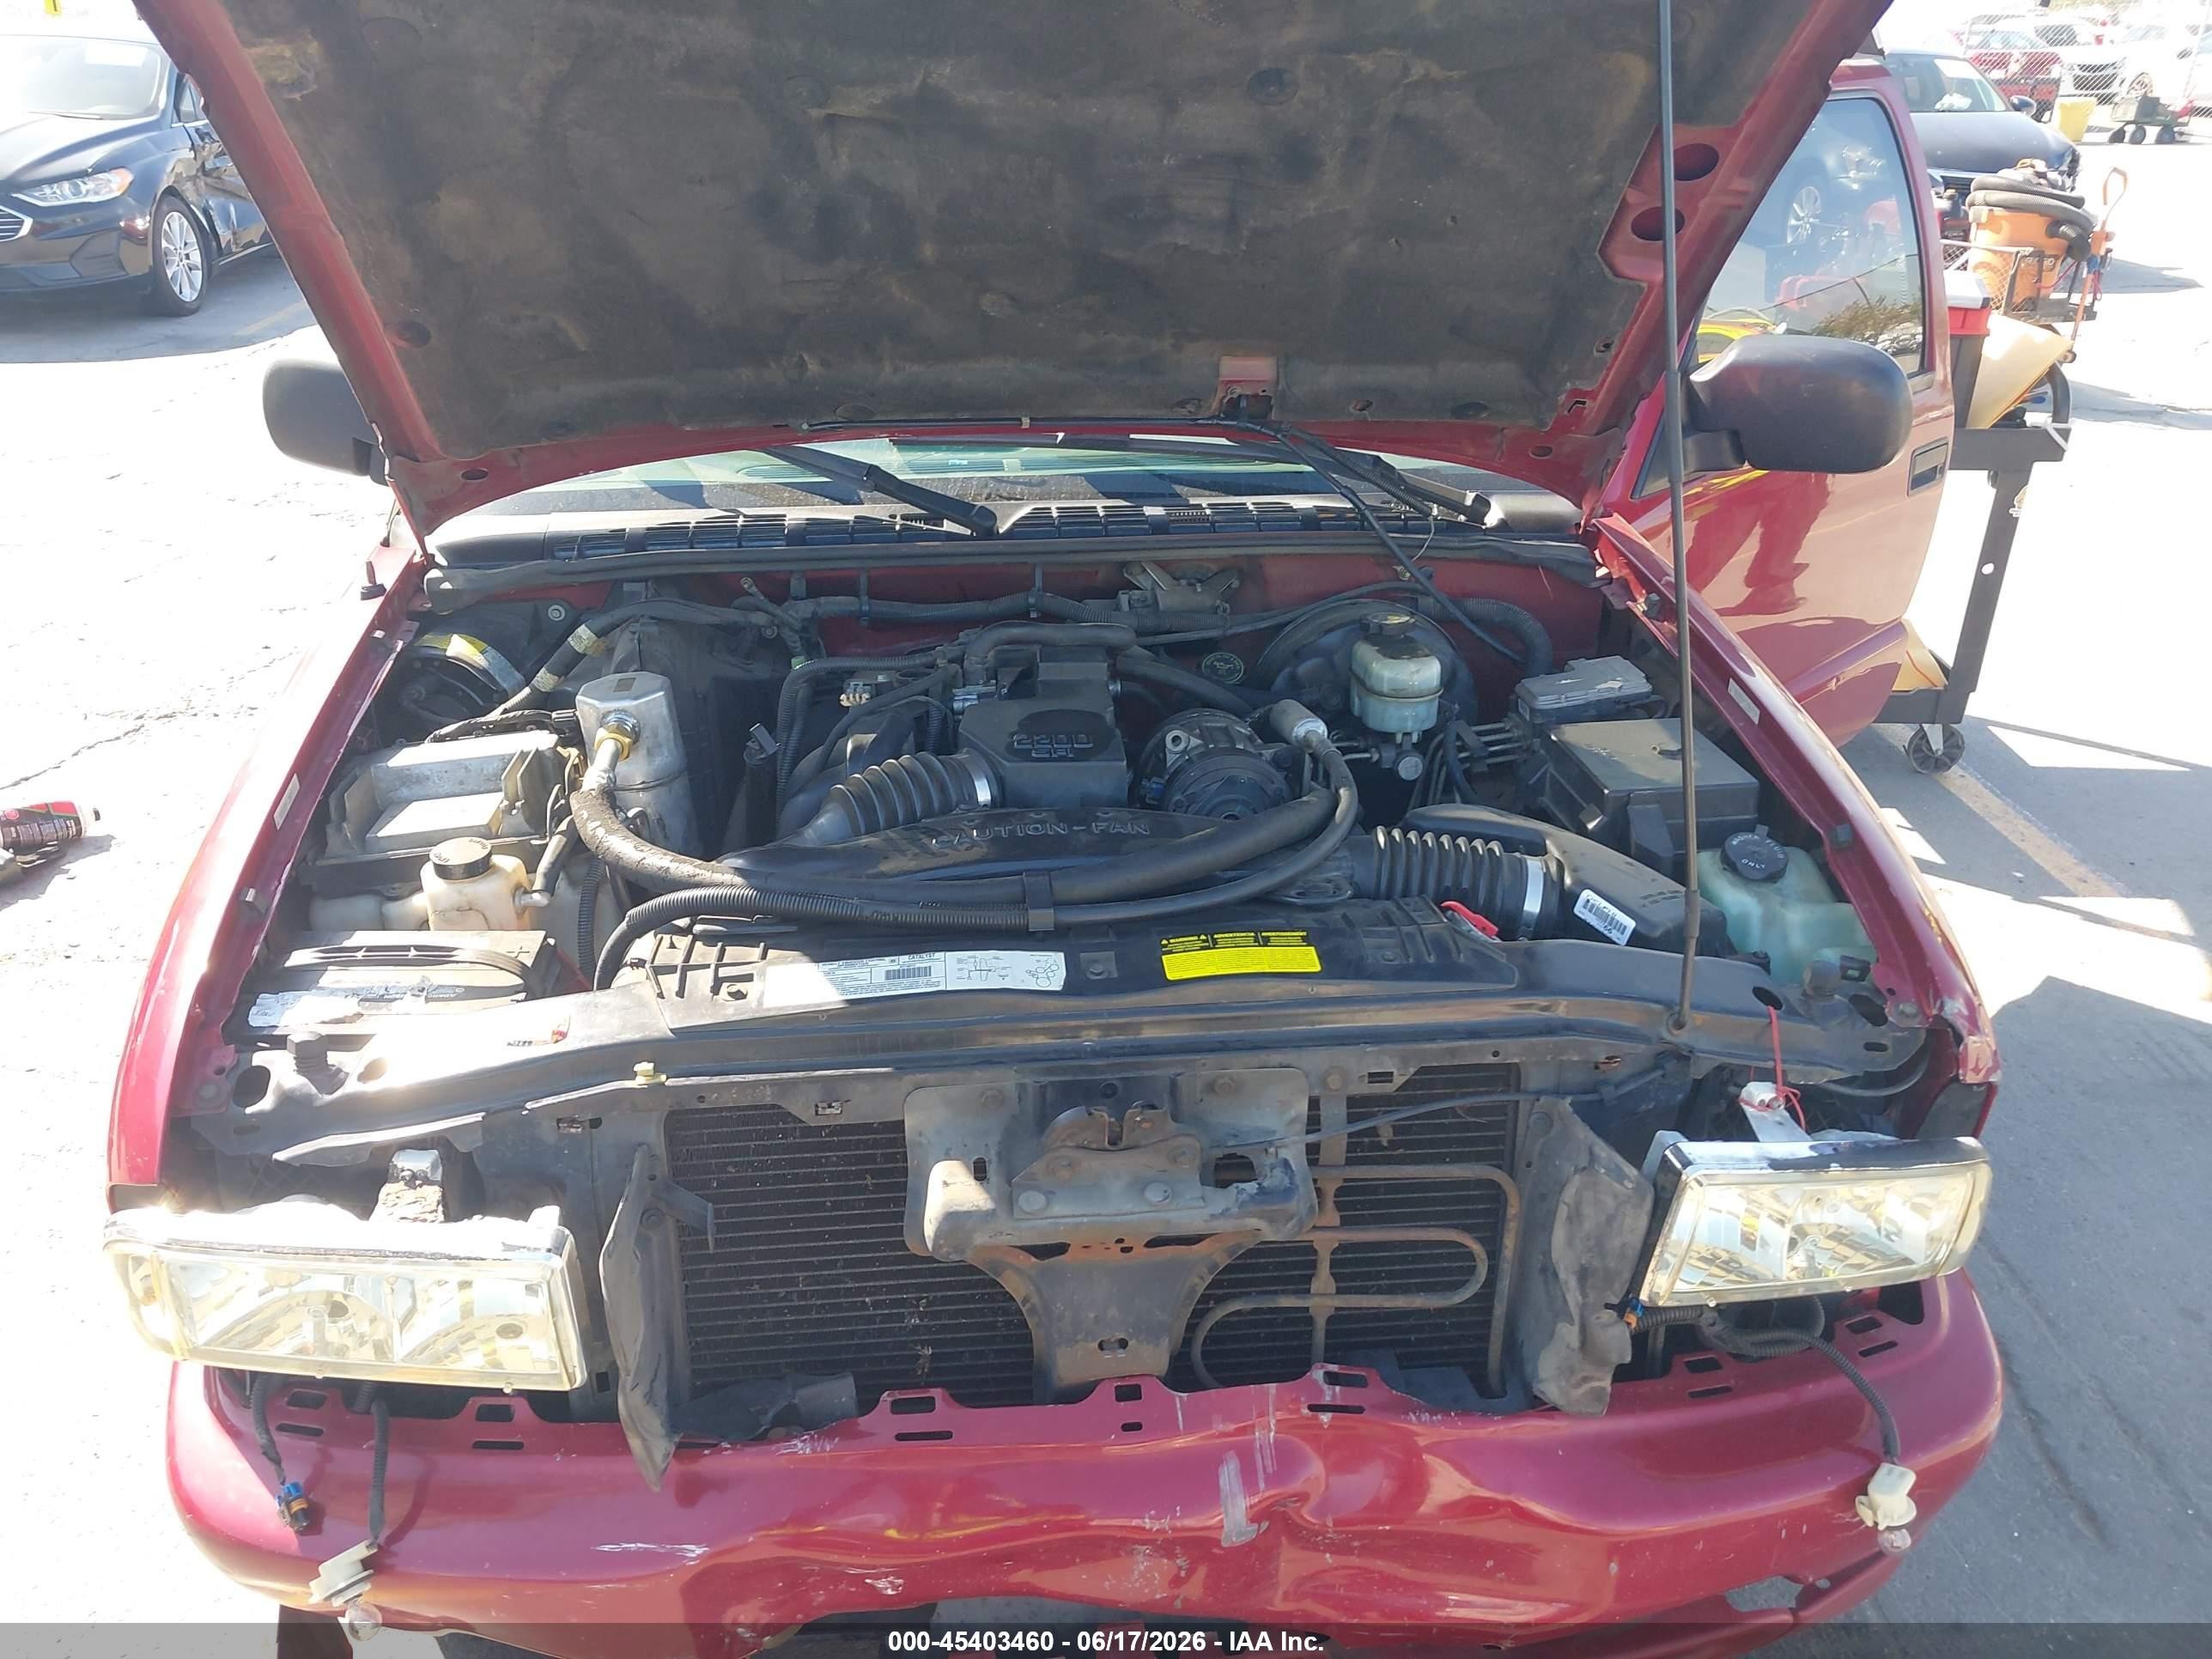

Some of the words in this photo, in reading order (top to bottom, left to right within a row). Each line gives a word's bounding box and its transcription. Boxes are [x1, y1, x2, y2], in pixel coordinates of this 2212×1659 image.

[933, 822, 1068, 848] CAUTION
[1091, 822, 1151, 836] FAN
[1765, 838, 1784, 859] FLUID
[1741, 859, 1765, 869] ONLY
